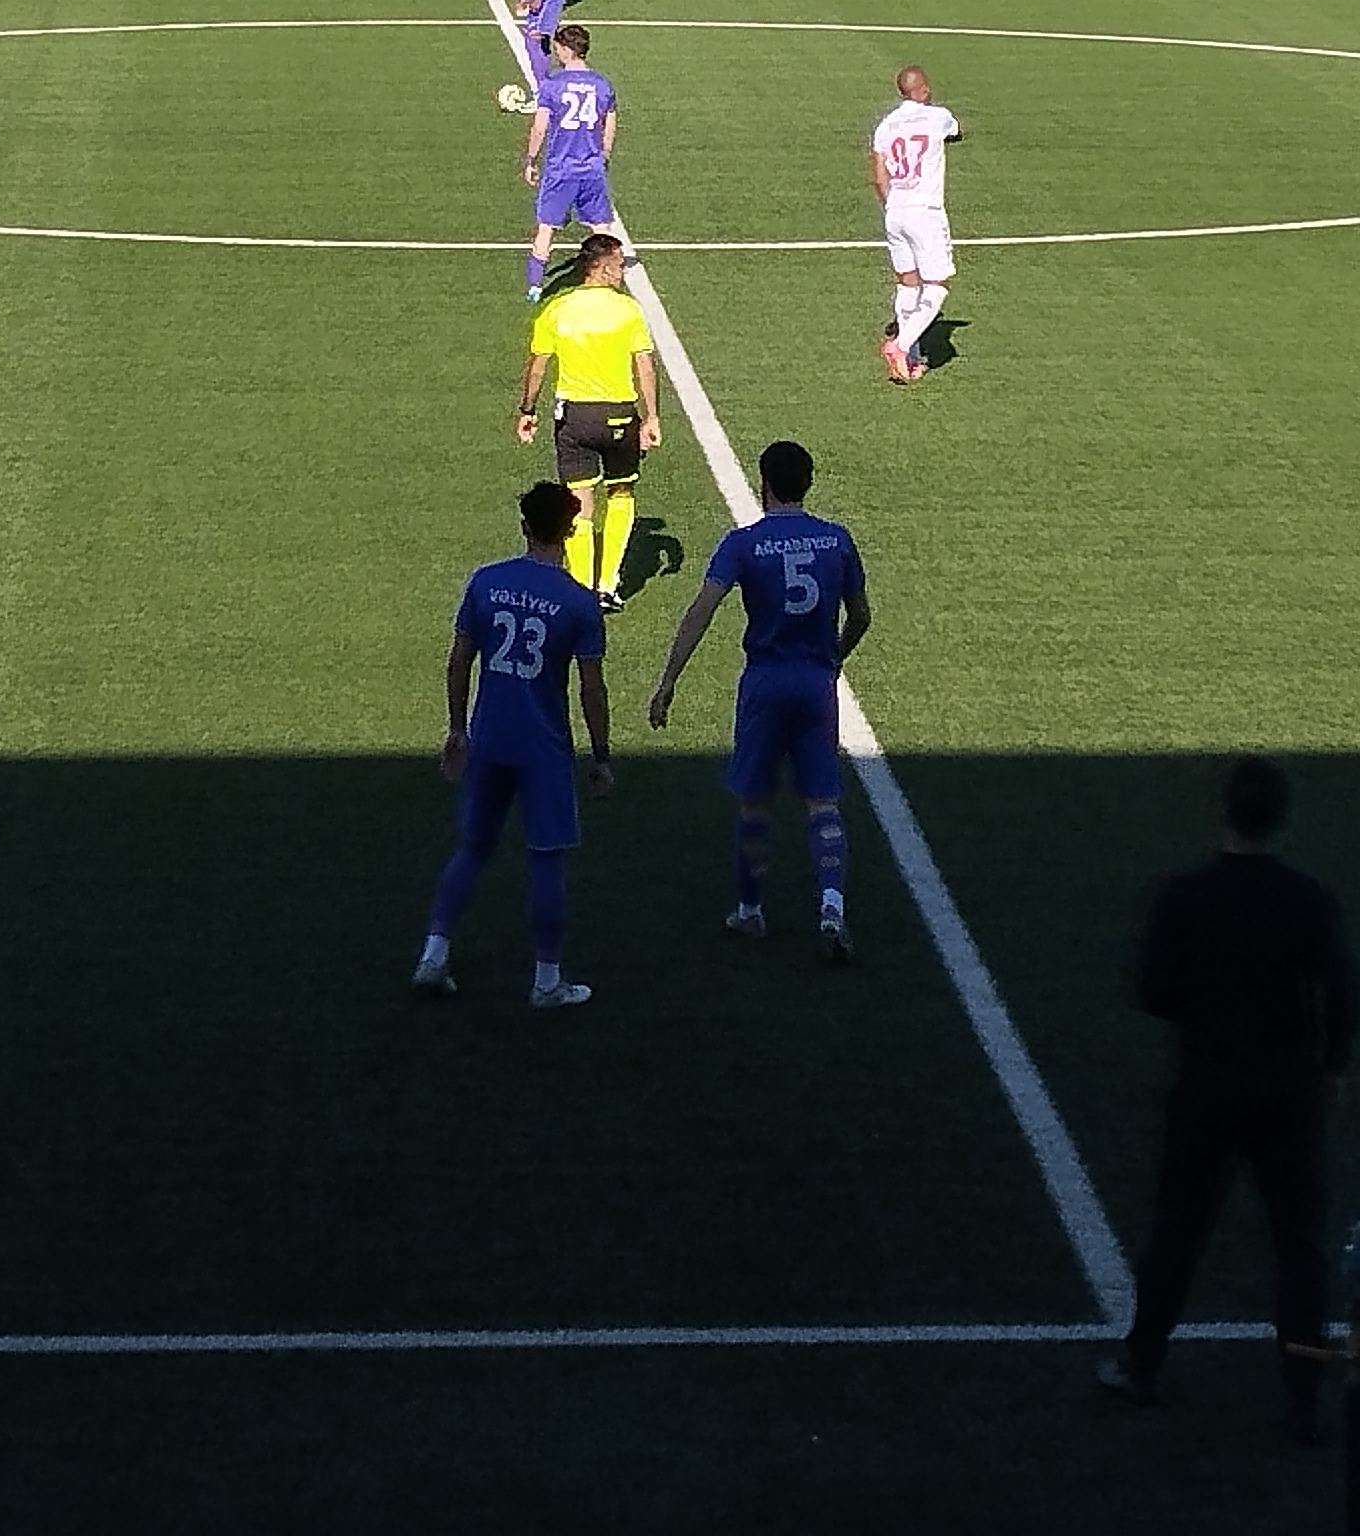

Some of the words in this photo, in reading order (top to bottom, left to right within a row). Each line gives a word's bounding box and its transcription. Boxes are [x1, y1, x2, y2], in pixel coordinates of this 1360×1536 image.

[560, 92, 599, 130] 24
[784, 551, 820, 614] 5
[489, 610, 547, 680] 23
